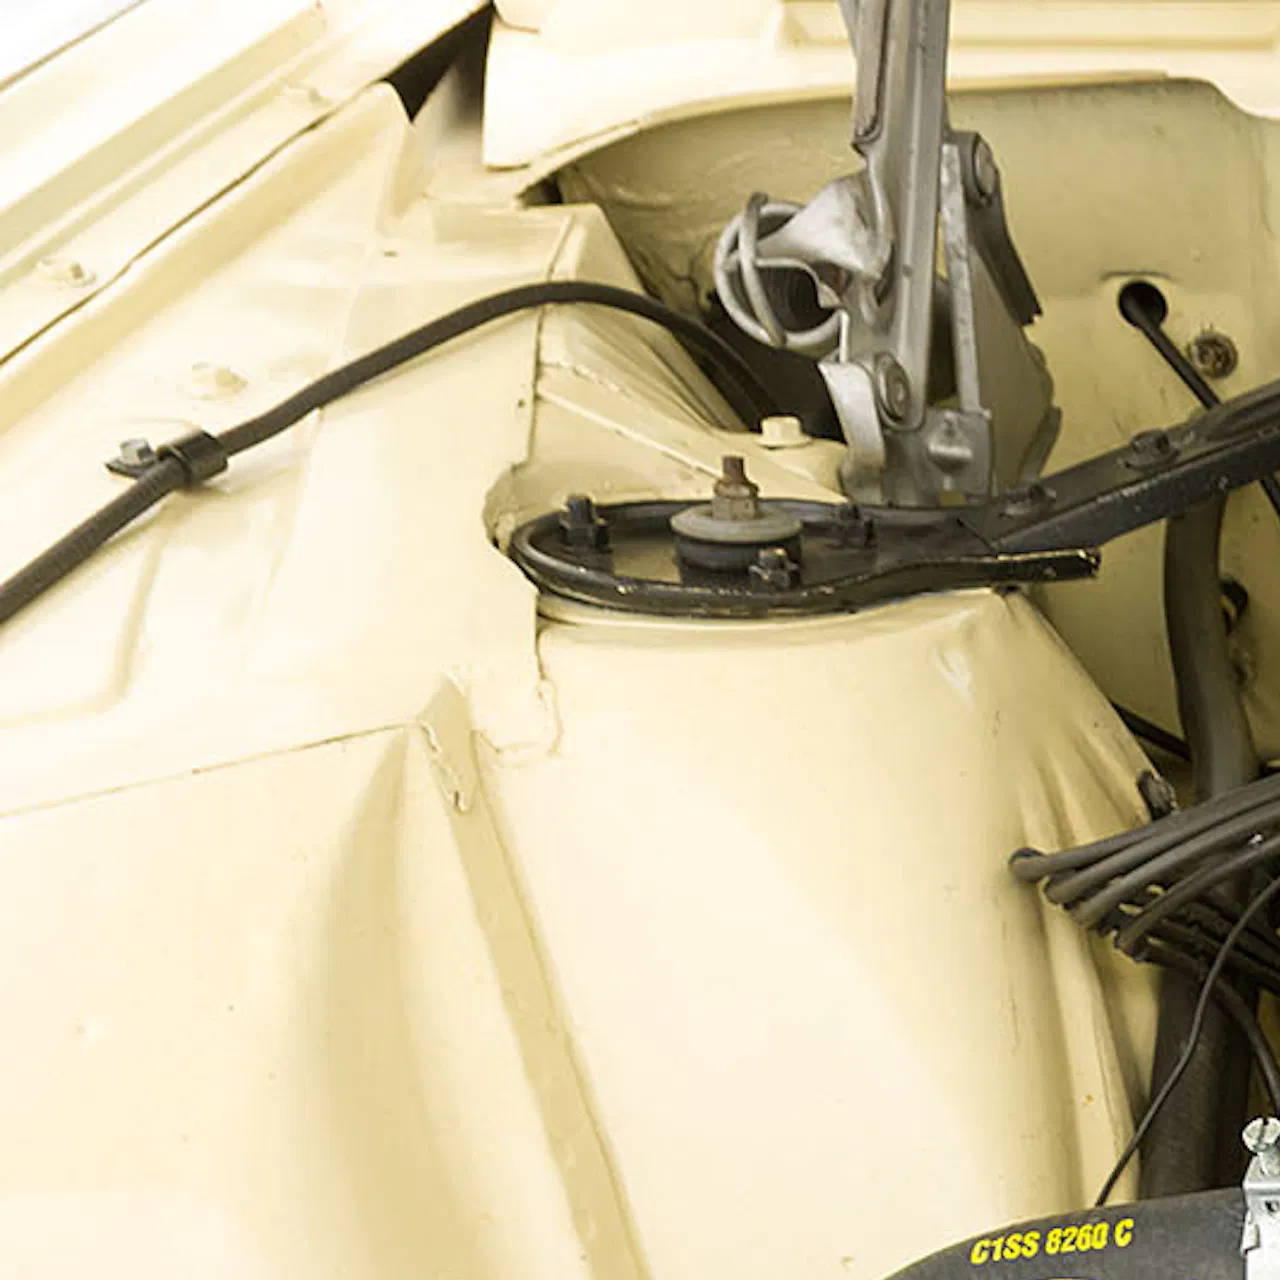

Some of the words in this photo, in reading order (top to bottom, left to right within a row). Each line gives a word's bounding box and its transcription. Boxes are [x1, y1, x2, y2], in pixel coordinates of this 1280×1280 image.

[970, 1230, 1041, 1265] C1SS
[1045, 1222, 1110, 1255] 8260
[1114, 1218, 1135, 1248] C
